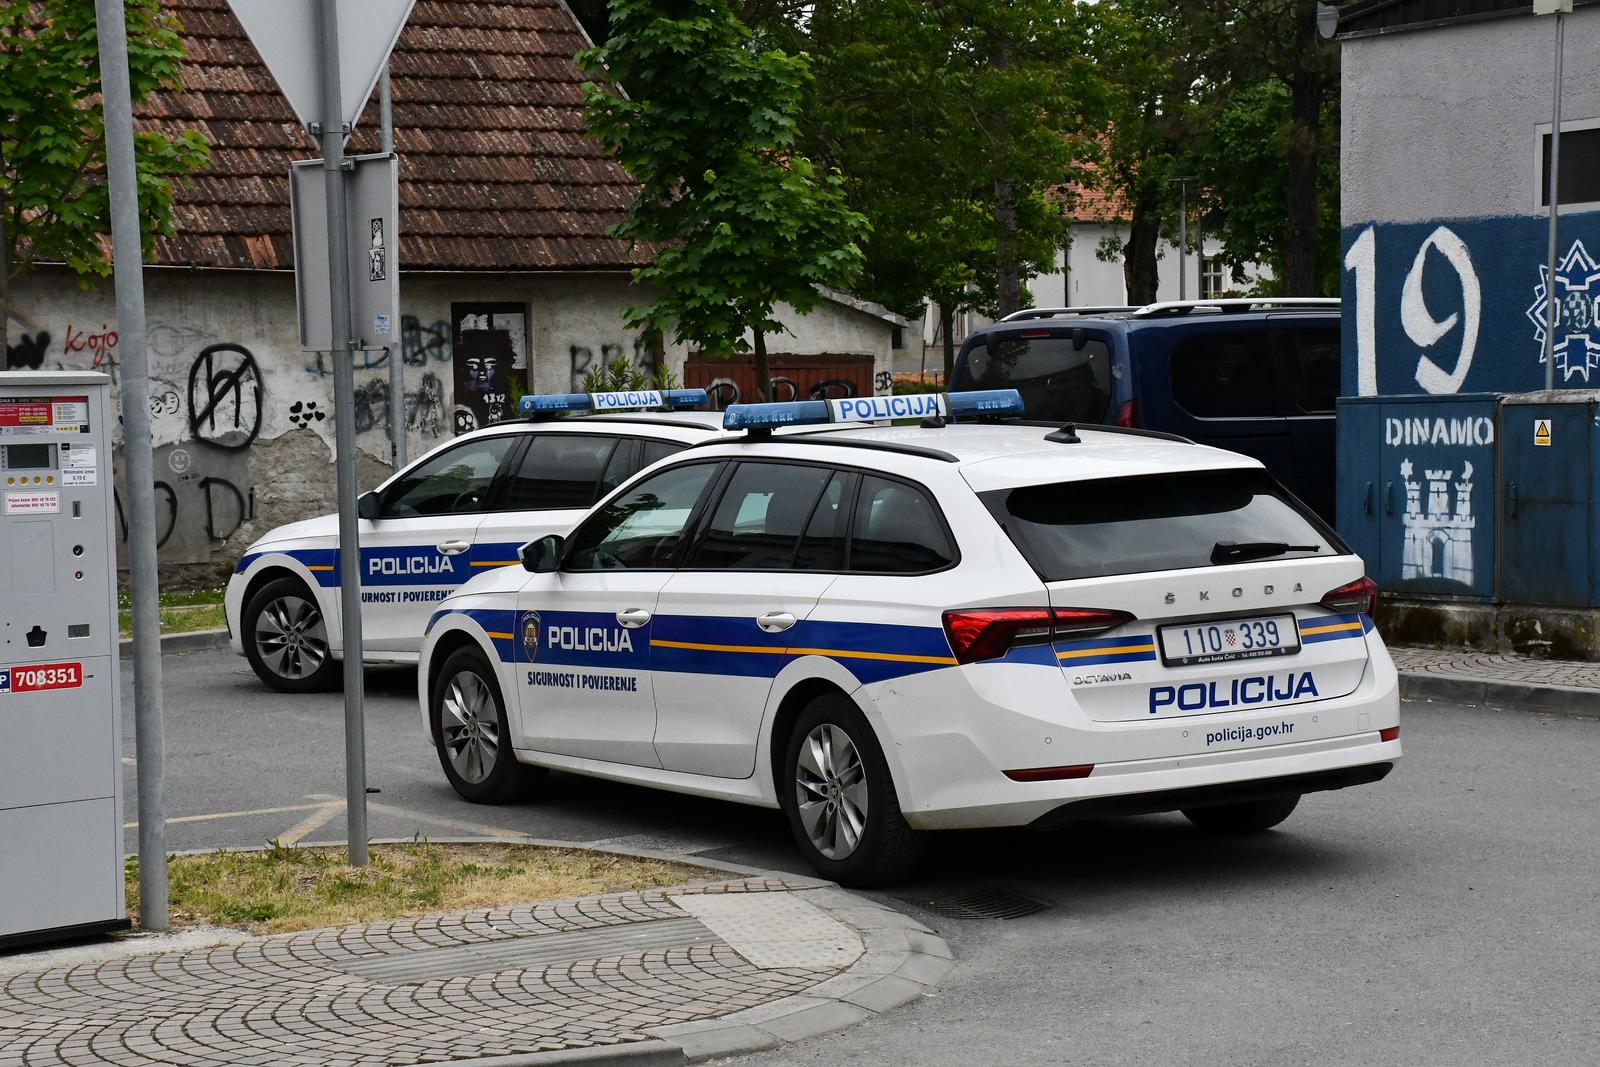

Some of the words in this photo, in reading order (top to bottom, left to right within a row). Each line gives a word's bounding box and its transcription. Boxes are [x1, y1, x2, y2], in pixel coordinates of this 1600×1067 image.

[1344, 225, 1482, 396] 19
[596, 391, 659, 407] POLICIJA
[840, 394, 941, 419] POLICIJA
[1385, 416, 1495, 447] DINAMO
[369, 556, 454, 575] POLICIJA
[361, 592, 395, 603] URNOST
[403, 589, 456, 603] POVJEREN
[1164, 583, 1304, 605] ŠKODA
[548, 625, 634, 653] POLICIJA
[1183, 625, 1222, 655] 110
[1239, 620, 1281, 650] 339
[15, 667, 78, 687] 708351
[527, 671, 575, 689] SIGURNOST
[576, 673, 580, 689] I
[582, 673, 638, 692] POVJERENJE
[1072, 671, 1132, 686] OCTAVIA
[1149, 671, 1319, 714] POLICIJA
[1206, 720, 1295, 746] policija.gov.hr
